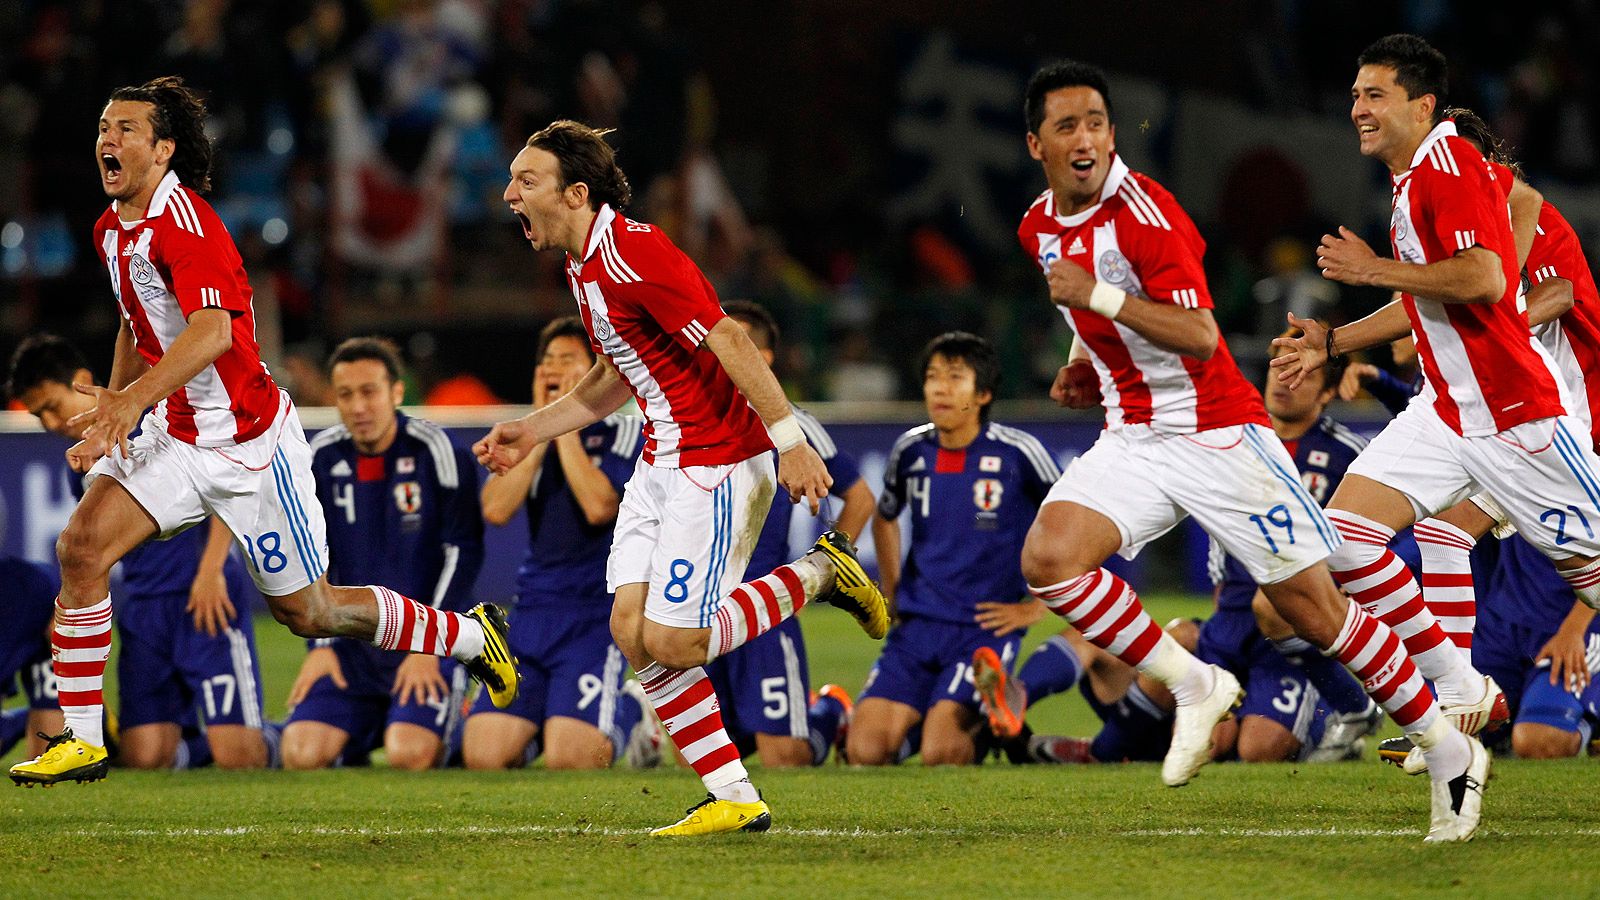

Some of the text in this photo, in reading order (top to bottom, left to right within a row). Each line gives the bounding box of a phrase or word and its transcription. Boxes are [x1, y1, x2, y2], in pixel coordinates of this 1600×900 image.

[334, 482, 357, 525] 4
[906, 476, 931, 518] 14
[1250, 504, 1295, 554] 19
[1540, 504, 1595, 546] 21
[243, 531, 288, 574] 18
[664, 558, 695, 604] 8
[202, 673, 238, 719] 17
[577, 673, 601, 711] 9
[761, 676, 788, 720] 5
[1272, 677, 1301, 715] 3
